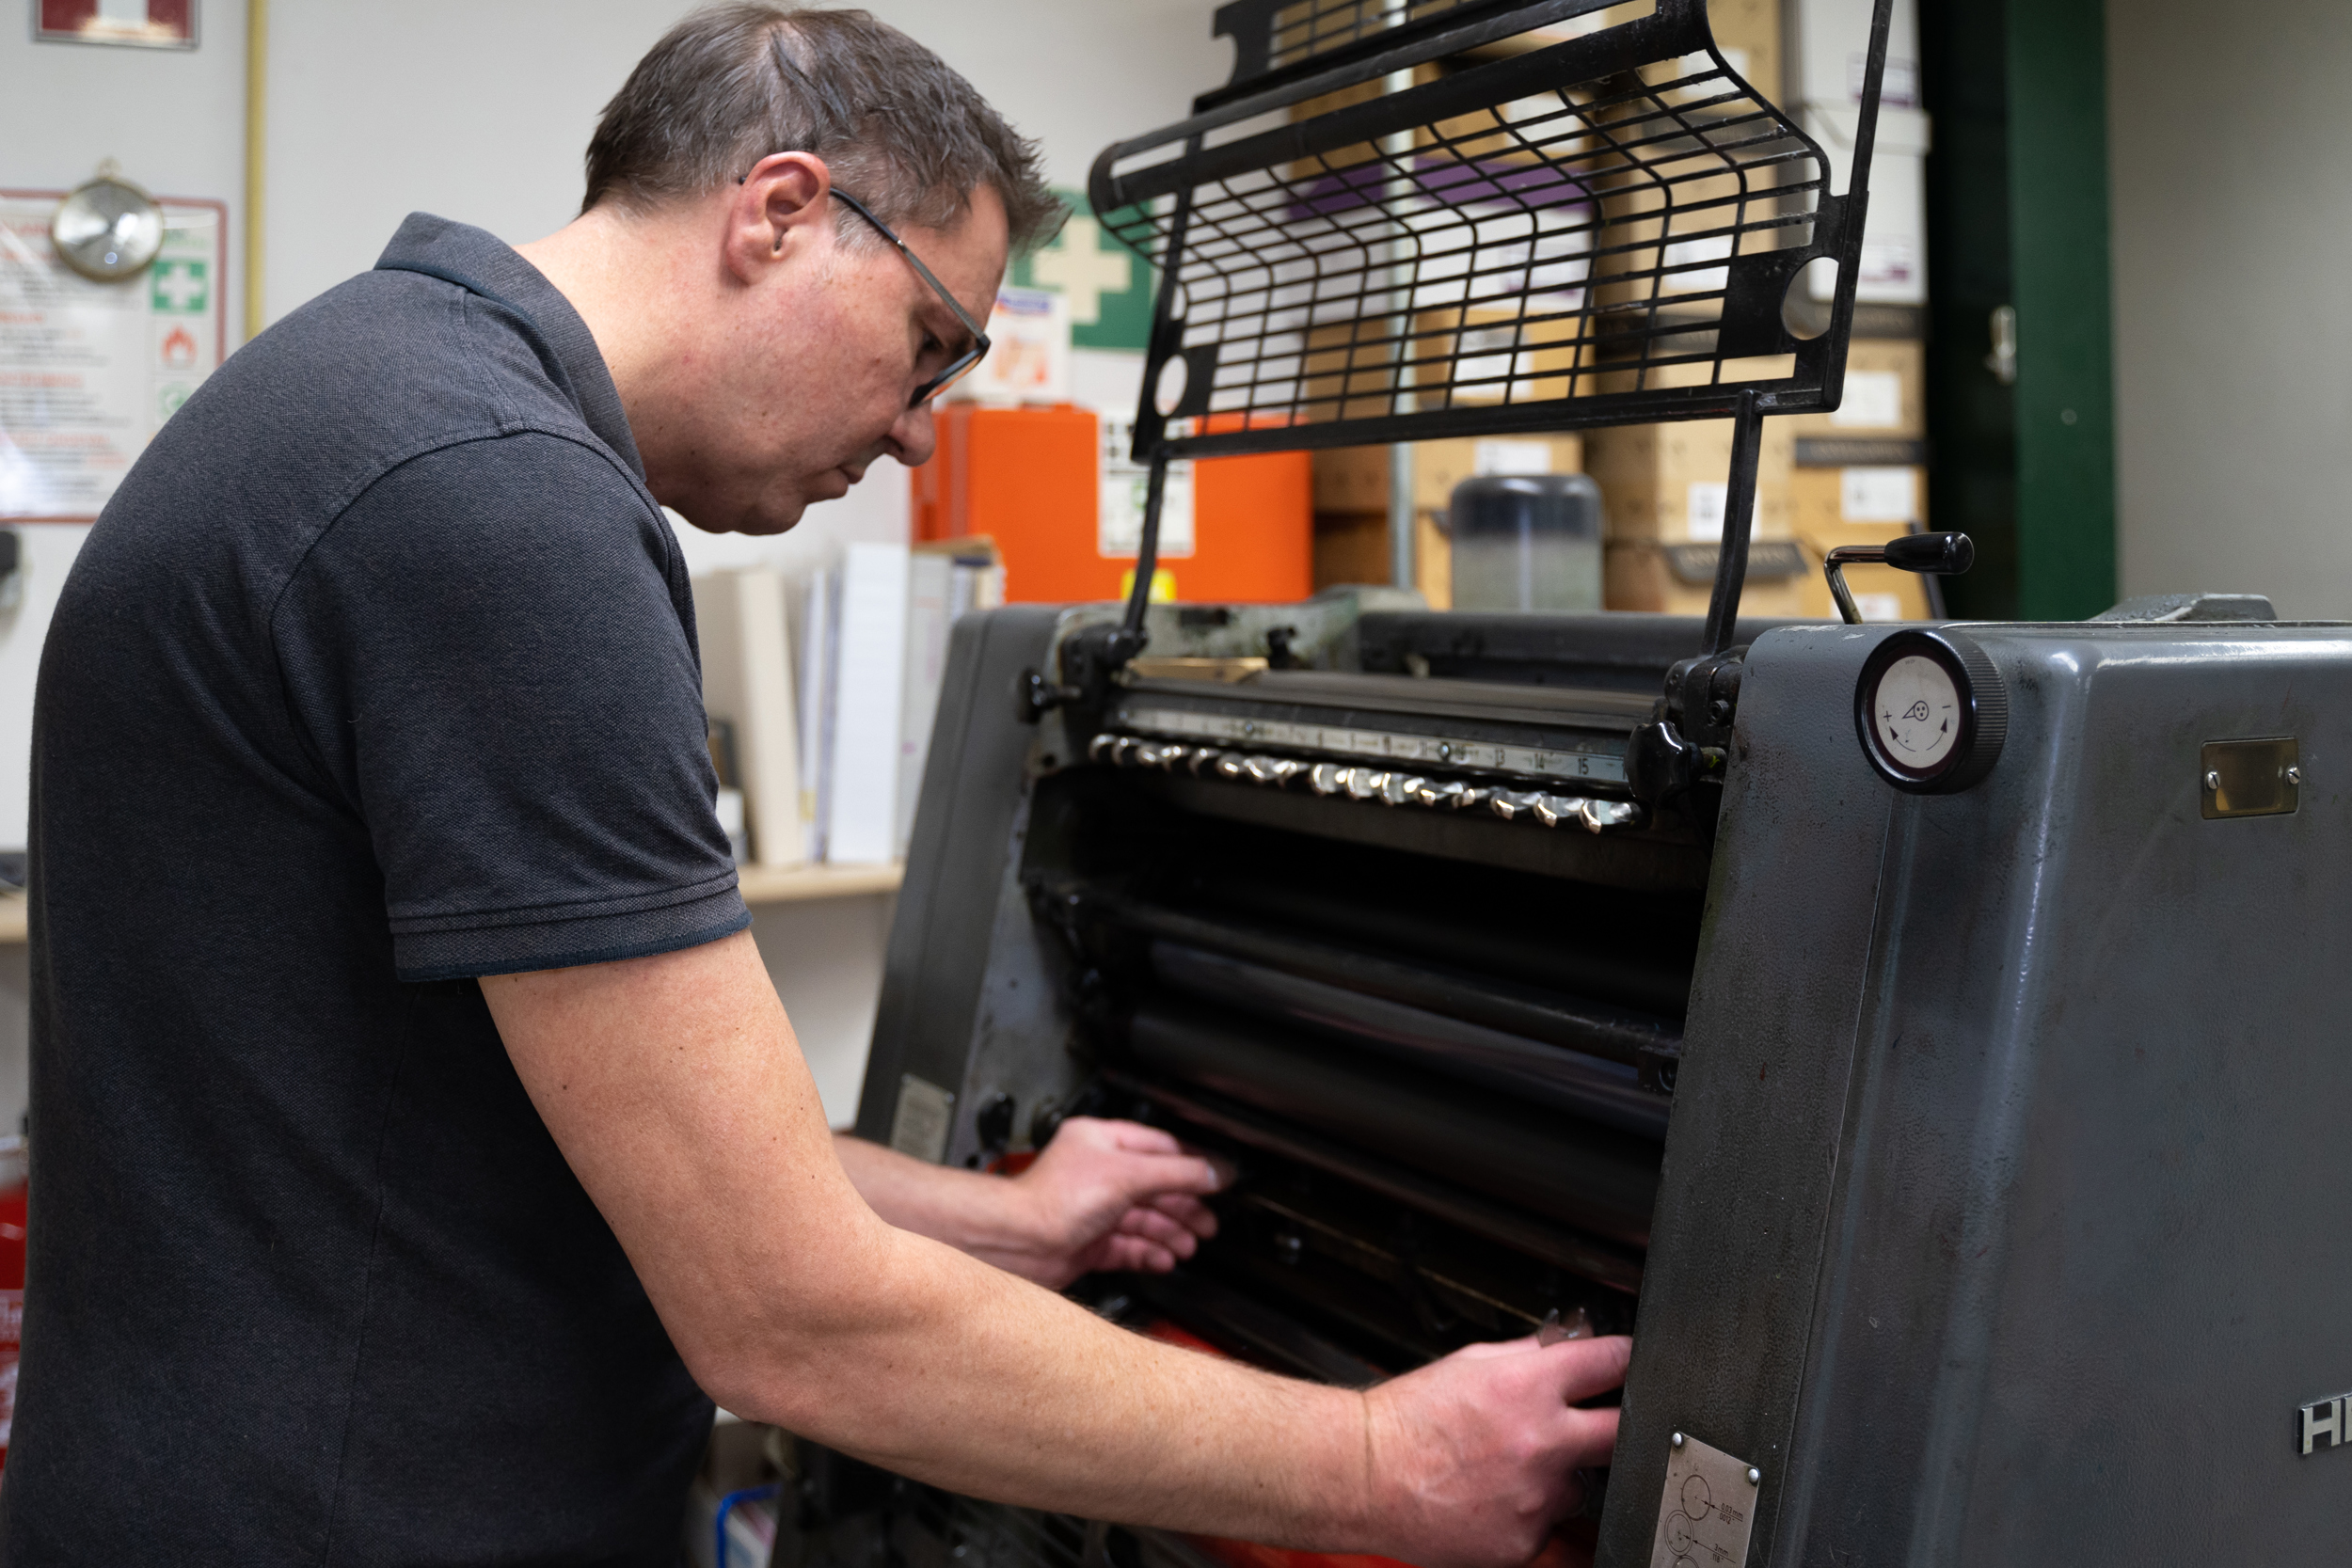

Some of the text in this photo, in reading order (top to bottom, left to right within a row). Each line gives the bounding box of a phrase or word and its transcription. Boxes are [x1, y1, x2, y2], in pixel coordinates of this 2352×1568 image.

[1494, 748, 1505, 767] 13
[1534, 753, 1545, 770] 14
[1578, 757, 1589, 775] 15
[1732, 1510, 1743, 1519] mm
